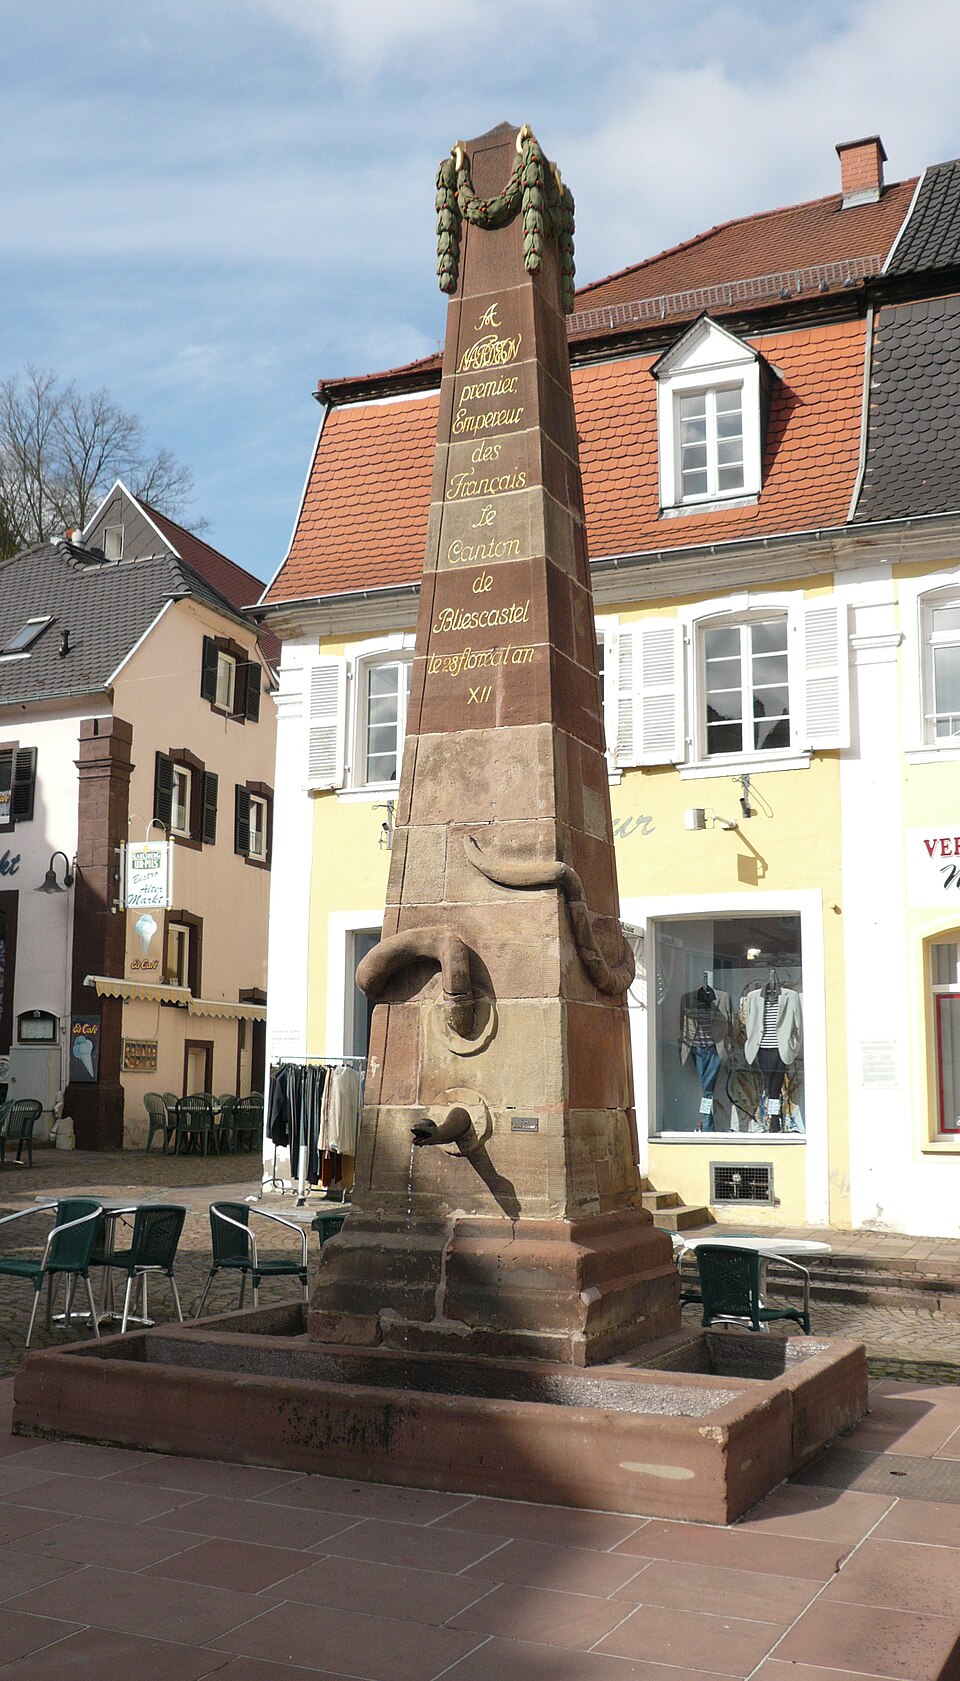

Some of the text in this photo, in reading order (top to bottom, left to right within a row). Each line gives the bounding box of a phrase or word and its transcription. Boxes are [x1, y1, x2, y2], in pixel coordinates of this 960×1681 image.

[452, 407, 525, 437] Empereur
[471, 440, 502, 463] des
[472, 503, 497, 529] Le
[447, 537, 521, 564] Canton
[472, 570, 494, 594] de
[432, 600, 530, 634] Bliescastel
[511, 648, 535, 664] an
[467, 685, 493, 705] XII
